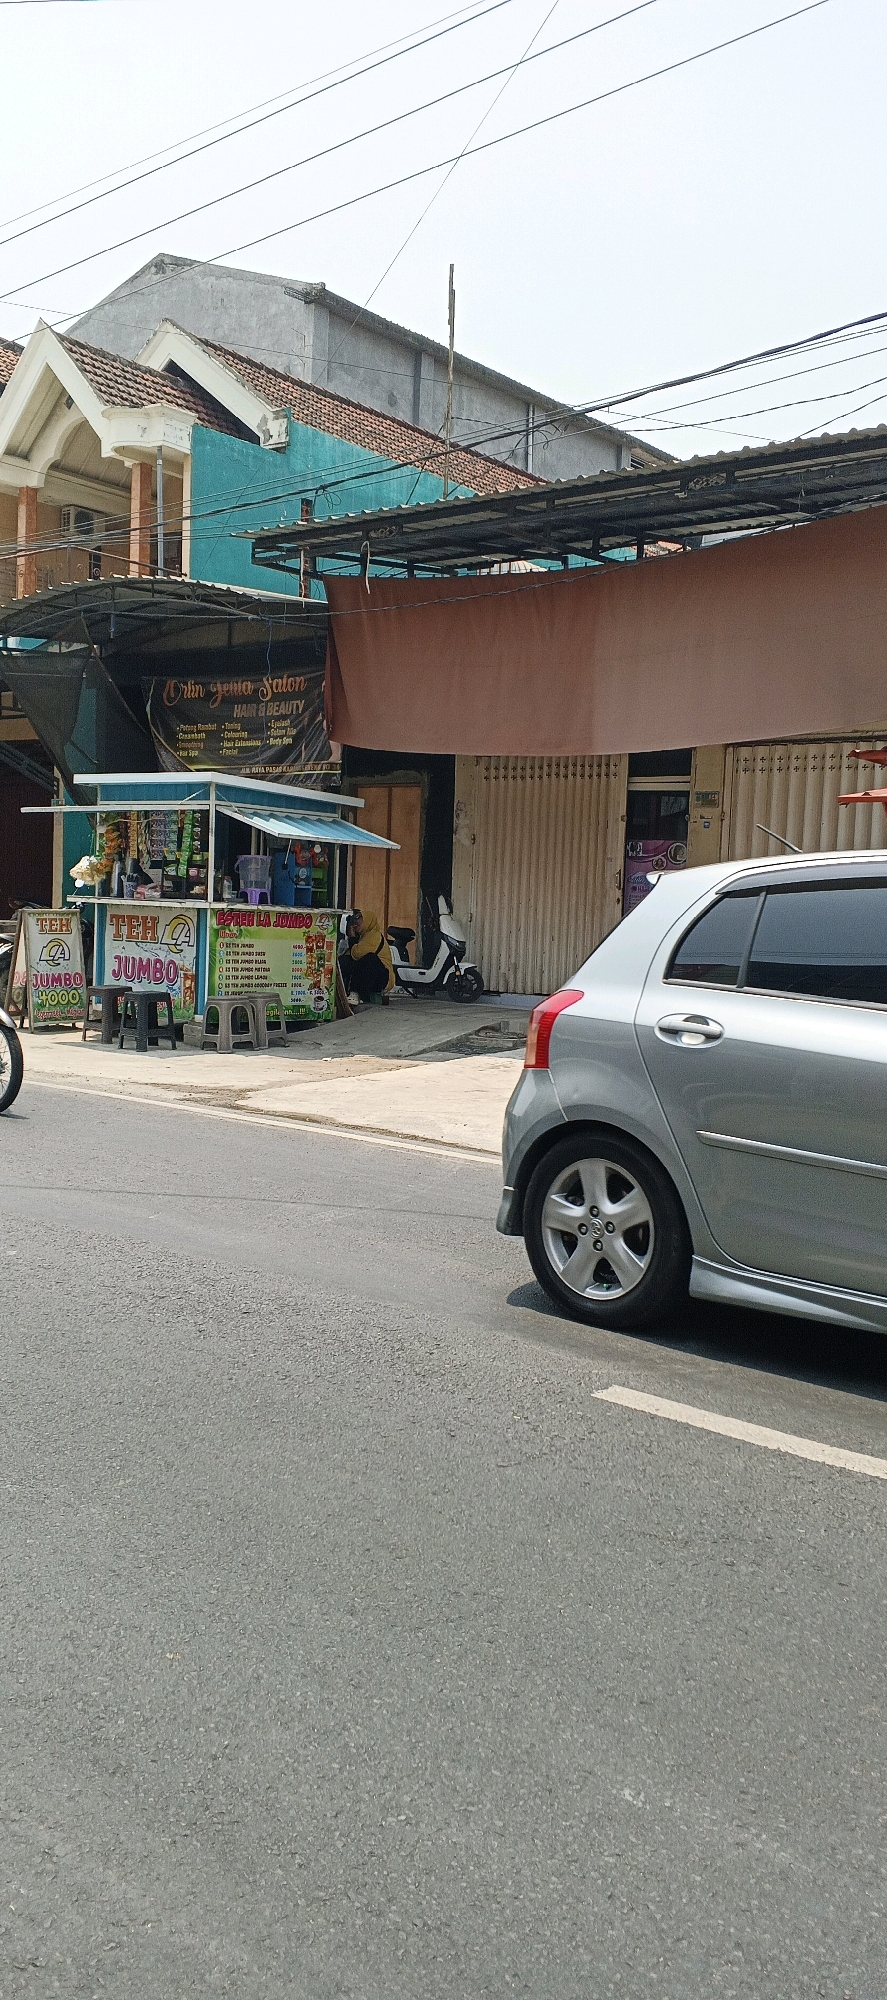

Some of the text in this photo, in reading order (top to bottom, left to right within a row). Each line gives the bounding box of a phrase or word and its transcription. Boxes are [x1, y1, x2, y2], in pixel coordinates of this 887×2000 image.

[259, 674, 307, 701] Salon
[234, 703, 256, 718] HAIR
[266, 700, 305, 715] BEAUTY
[224, 731, 248, 739] Colouring
[36, 917, 72, 934] TEH
[109, 914, 159, 943] TEH
[256, 911, 271, 927] LA
[273, 913, 313, 929] JUMBO
[111, 954, 179, 986] JUMBO
[32, 972, 84, 990] JUMBO
[38, 988, 80, 1006] 4000
